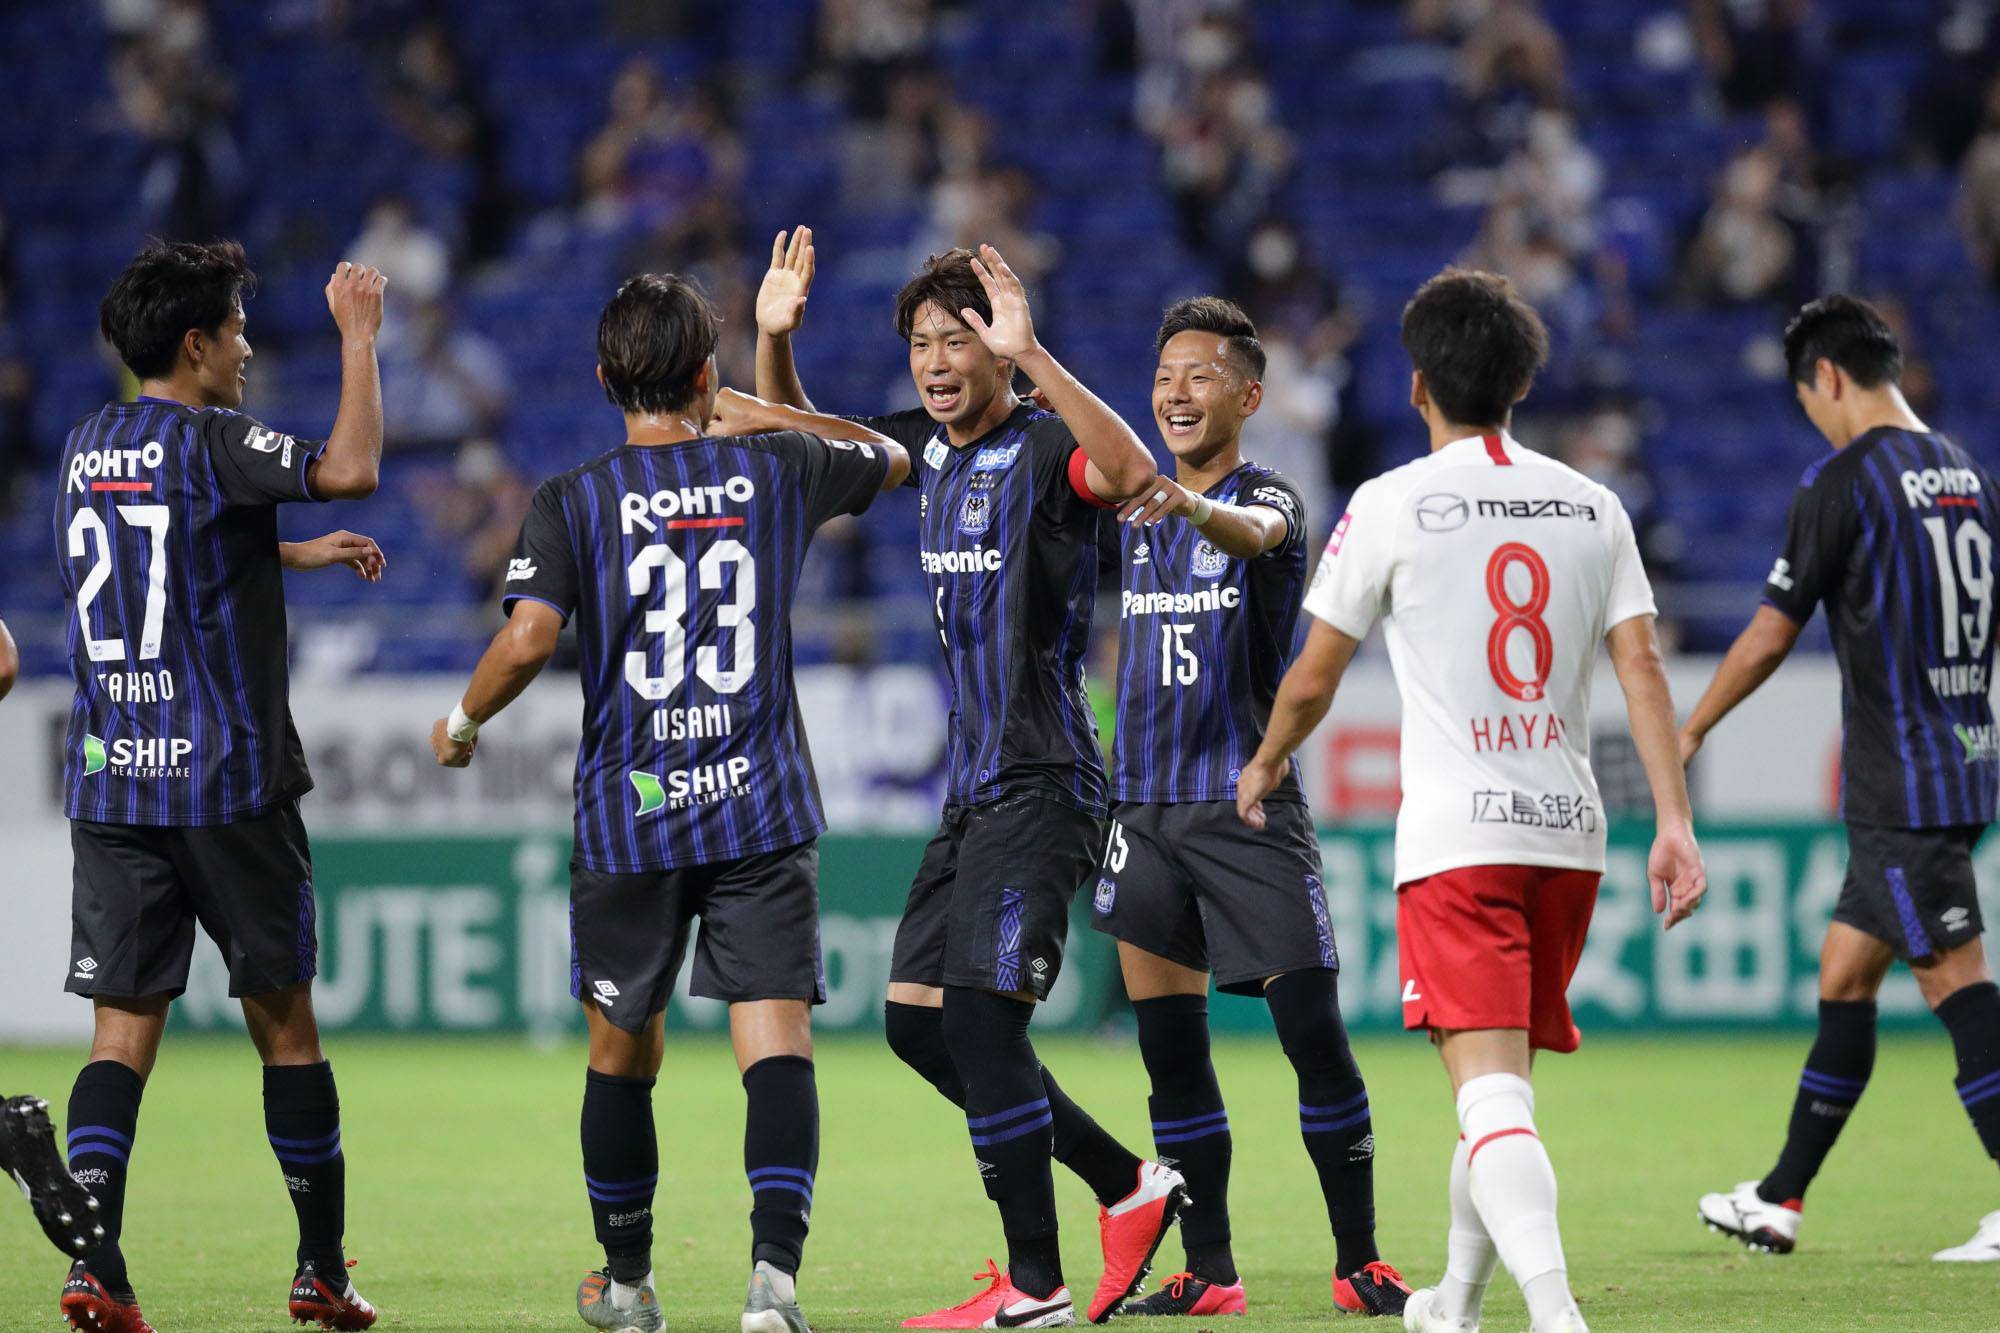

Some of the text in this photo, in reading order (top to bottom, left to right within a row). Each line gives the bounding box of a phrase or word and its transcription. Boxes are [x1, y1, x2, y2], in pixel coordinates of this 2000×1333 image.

[67, 441, 164, 494] ROHTO
[620, 475, 755, 535] ROHTO
[68, 505, 170, 662] 27
[1922, 516, 1995, 659] 19
[625, 539, 756, 700] 33
[1485, 541, 1554, 702] 8
[1161, 623, 1199, 686] 15
[653, 704, 732, 741] USAMI
[1471, 713, 1567, 752] HAYA
[110, 738, 193, 767] SHIP
[111, 765, 190, 778] HEALTHCARE
[668, 756, 751, 799] SHIP
[670, 783, 752, 810] HEALTHCARE
[1471, 788, 1597, 833] 広島銀行
[293, 1287, 318, 1297] COPA
